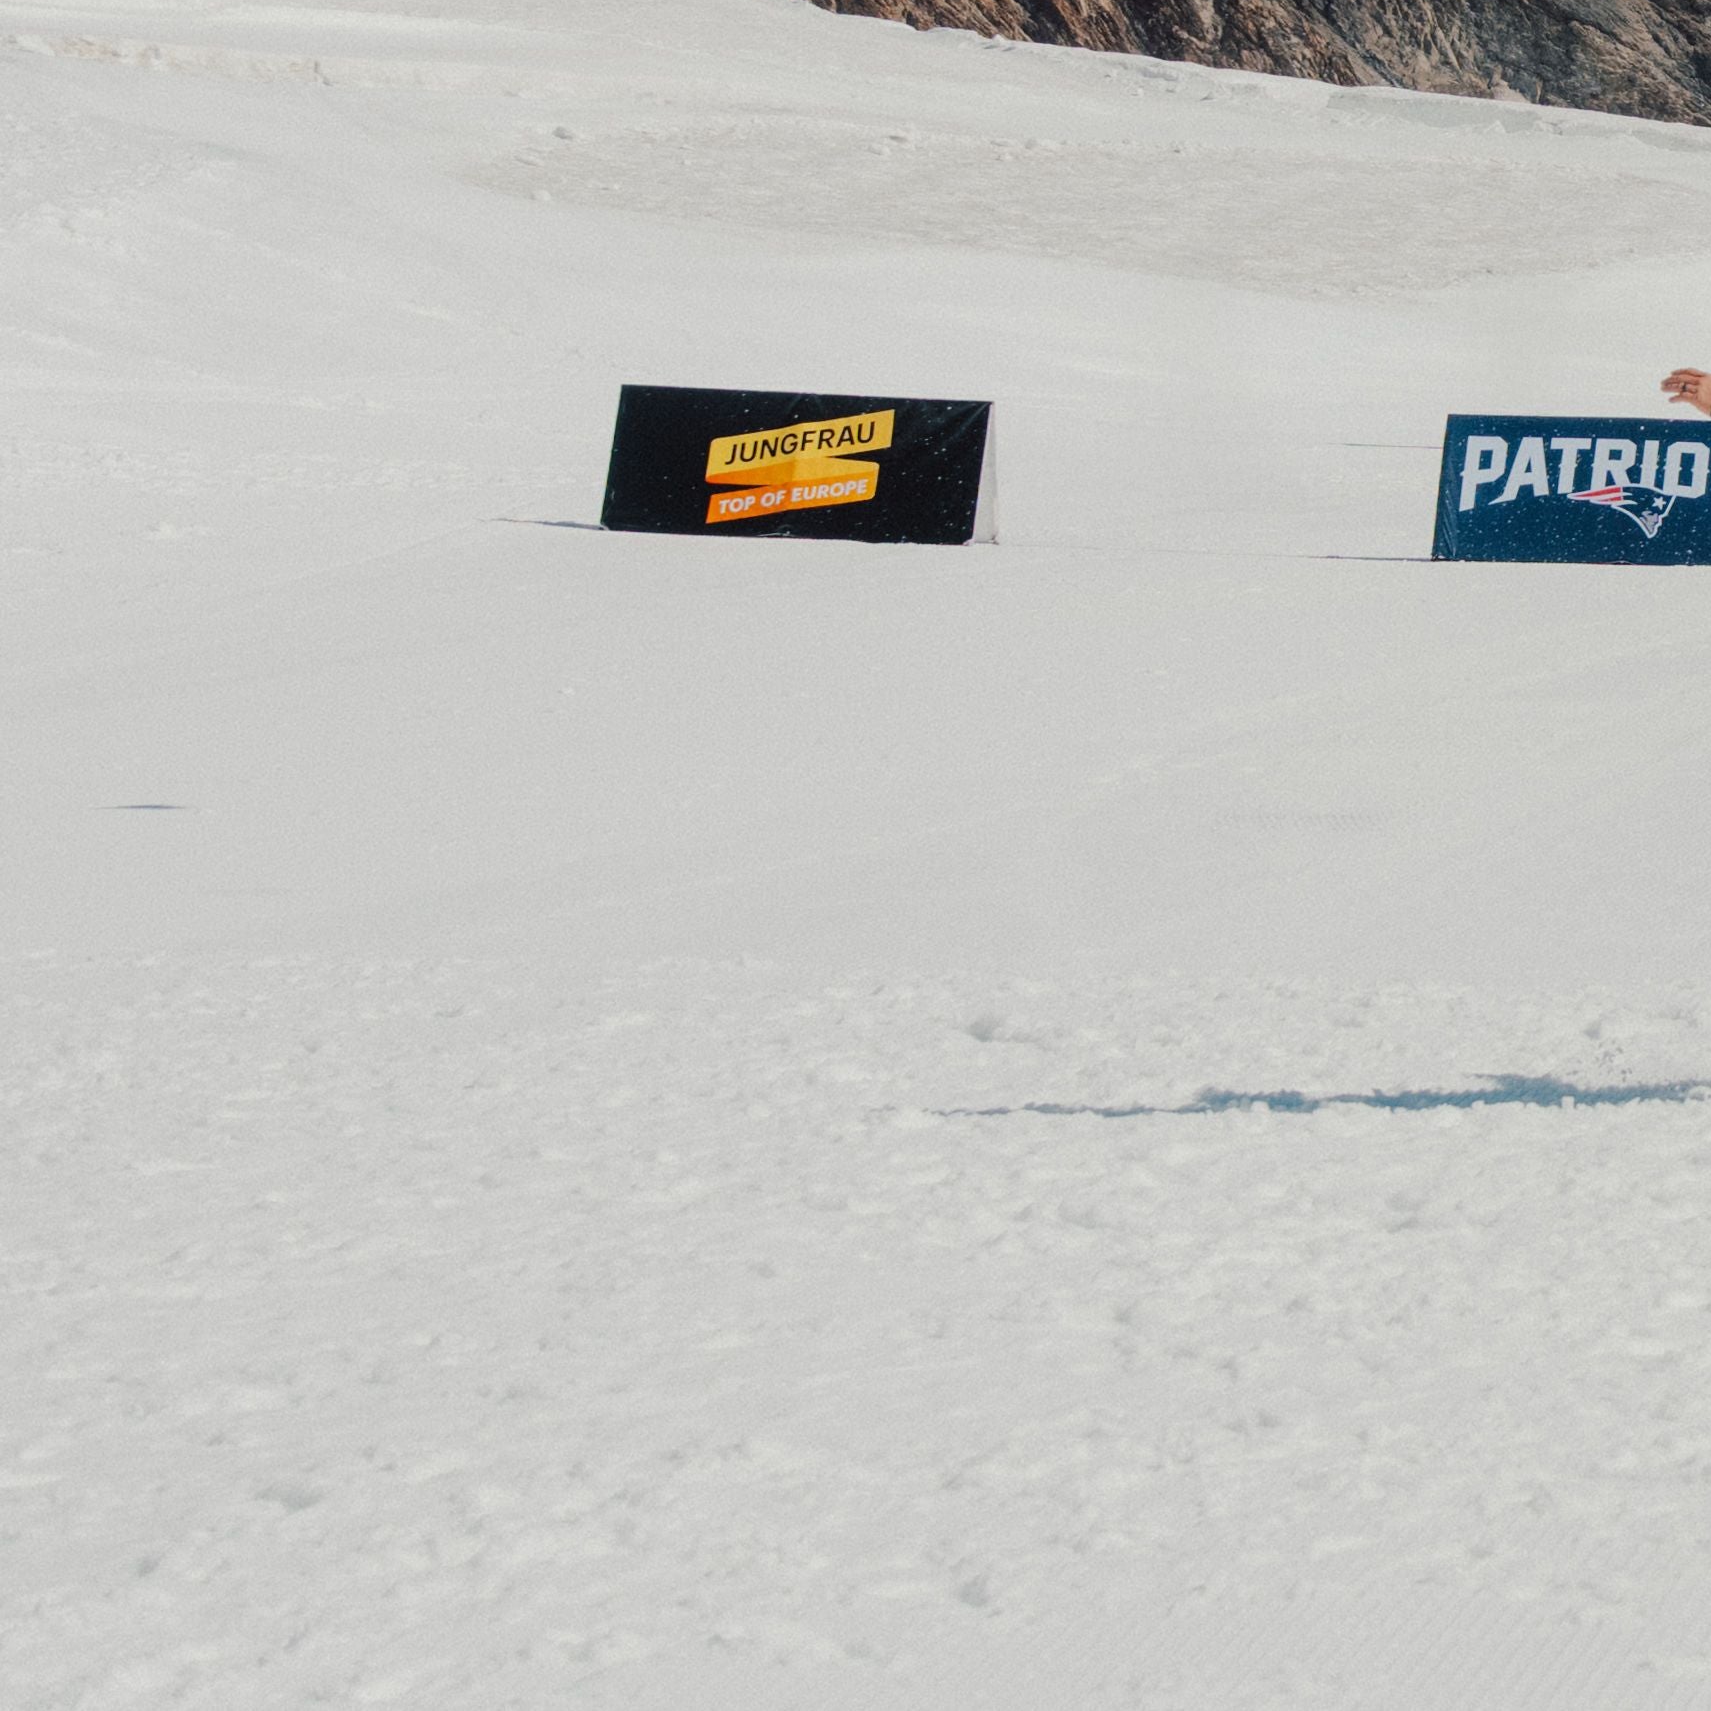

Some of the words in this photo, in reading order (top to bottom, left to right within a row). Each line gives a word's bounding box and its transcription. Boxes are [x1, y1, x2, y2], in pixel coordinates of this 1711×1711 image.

[725, 421, 876, 465] JUNGFRAU
[719, 494, 756, 515] TOP
[760, 489, 786, 507] OF
[790, 478, 869, 502] EUROPE
